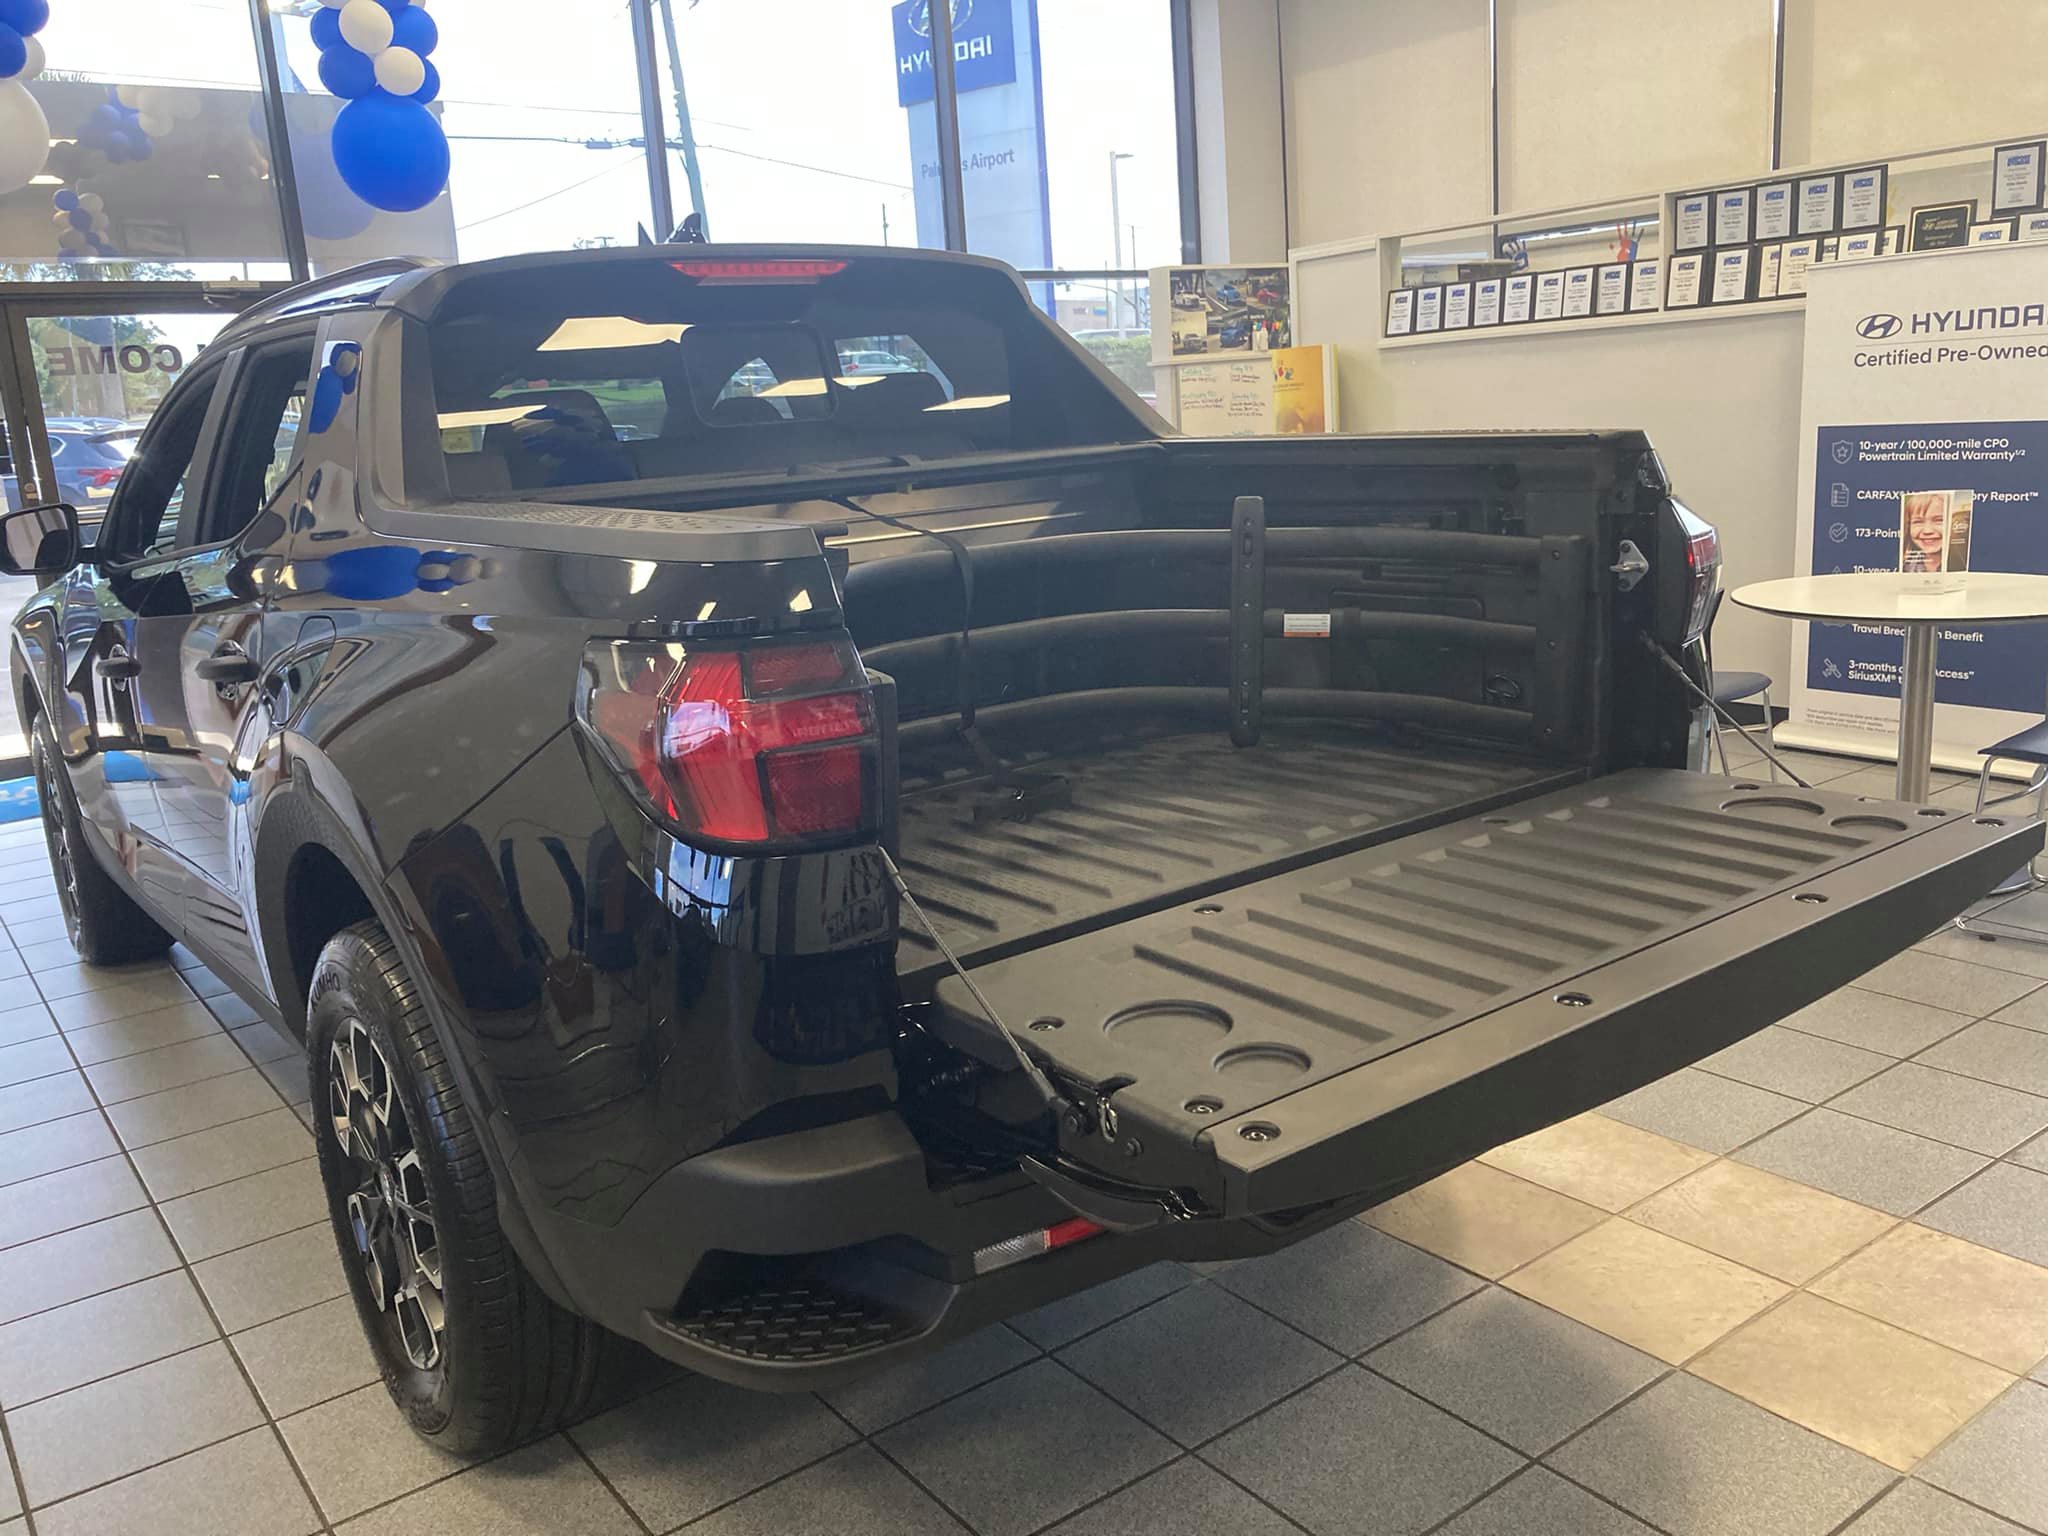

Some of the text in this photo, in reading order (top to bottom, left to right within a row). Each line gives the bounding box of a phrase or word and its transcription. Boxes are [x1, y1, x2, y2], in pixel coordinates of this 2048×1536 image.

[971, 148, 1015, 171] Airport
[1911, 304, 2048, 334] HYUNDA
[1854, 348, 1931, 367] Certified
[1859, 440, 1898, 451] 10-year
[1907, 439, 1981, 450] 100,000-mile
[1984, 438, 2009, 448] CPO
[1859, 451, 1915, 461] Powertrain
[1918, 451, 1959, 461] Limited
[1852, 624, 1881, 634] Travel
[1945, 630, 1984, 642] Benefit
[1848, 660, 1896, 673] 3-months
